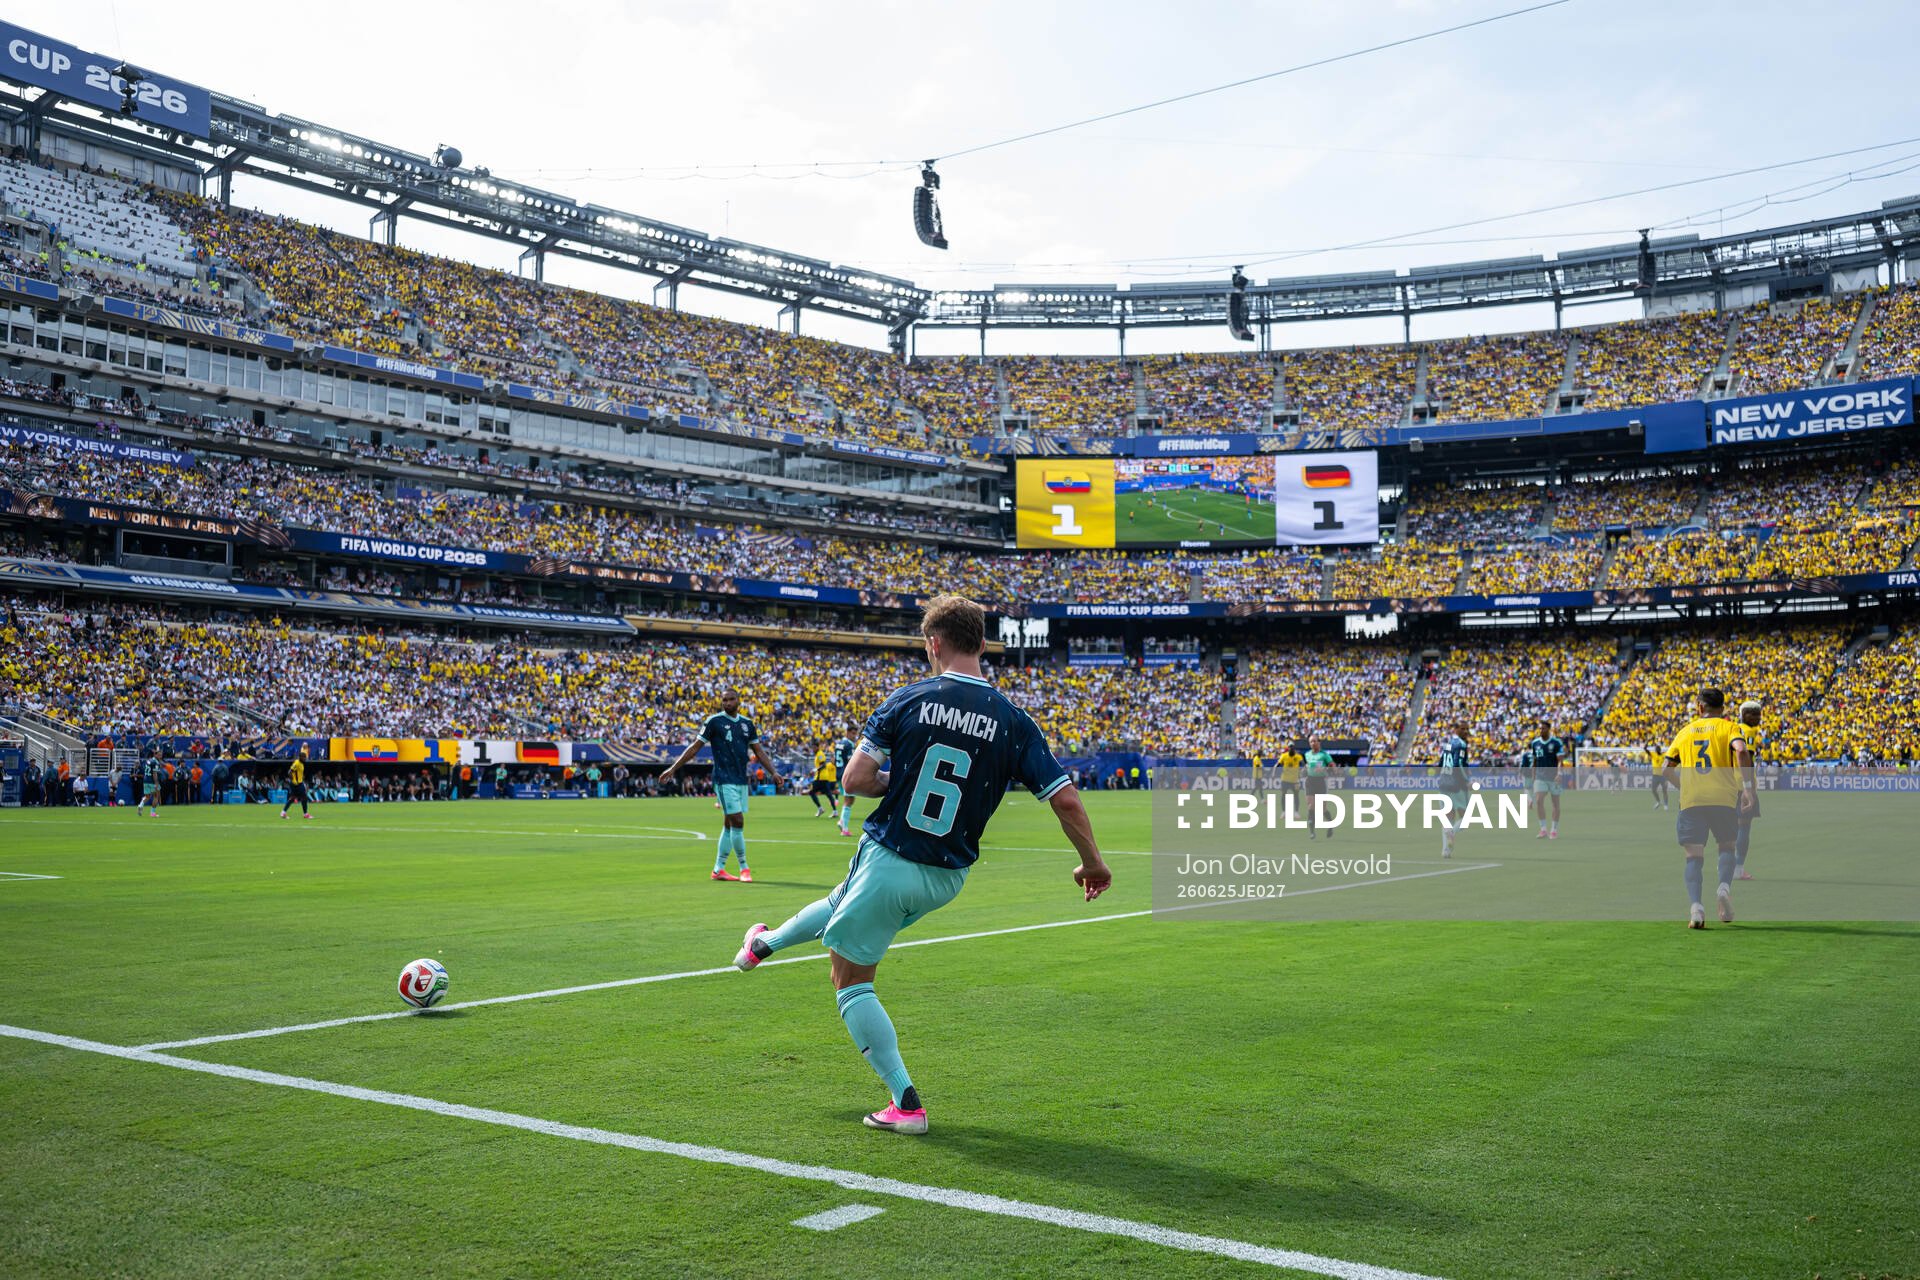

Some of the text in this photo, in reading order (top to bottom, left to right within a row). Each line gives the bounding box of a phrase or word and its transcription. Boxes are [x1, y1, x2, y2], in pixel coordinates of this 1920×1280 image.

[8, 39, 188, 114] CUP 2026
[376, 358, 437, 380] #FIFAWorldCup
[1715, 387, 1906, 425] NEW YORK
[1715, 409, 1906, 444] NEW JERSEY
[23, 429, 72, 446] YORK
[76, 439, 114, 454] NEW
[119, 444, 182, 463] JERSEY
[838, 442, 941, 464] NEW YRK NEW JERSEY
[1158, 438, 1230, 451] #FIFAWorldCup
[89, 507, 119, 521] NEW
[124, 511, 158, 526] YORK
[192, 520, 239, 536] JERSEY
[1051, 504, 1083, 536] 1
[1313, 500, 1344, 531] 1
[341, 537, 487, 565] FIFA WORLD CUP 2026
[1888, 574, 1917, 586] FIFA
[1066, 604, 1190, 616] FIFA WORLD CUP 2026
[919, 702, 997, 742] KIMMICH
[424, 740, 444, 763] 1
[473, 742, 492, 765] 1
[1694, 740, 1712, 775] 3
[905, 743, 972, 837] 6
[1192, 776, 1229, 790] ADI
[1354, 776, 1385, 787] FIFA'S
[1387, 776, 1441, 788] PREDICTIO
[1791, 776, 1830, 788] FIFA'S
[1834, 776, 1919, 790] PREDICTION
